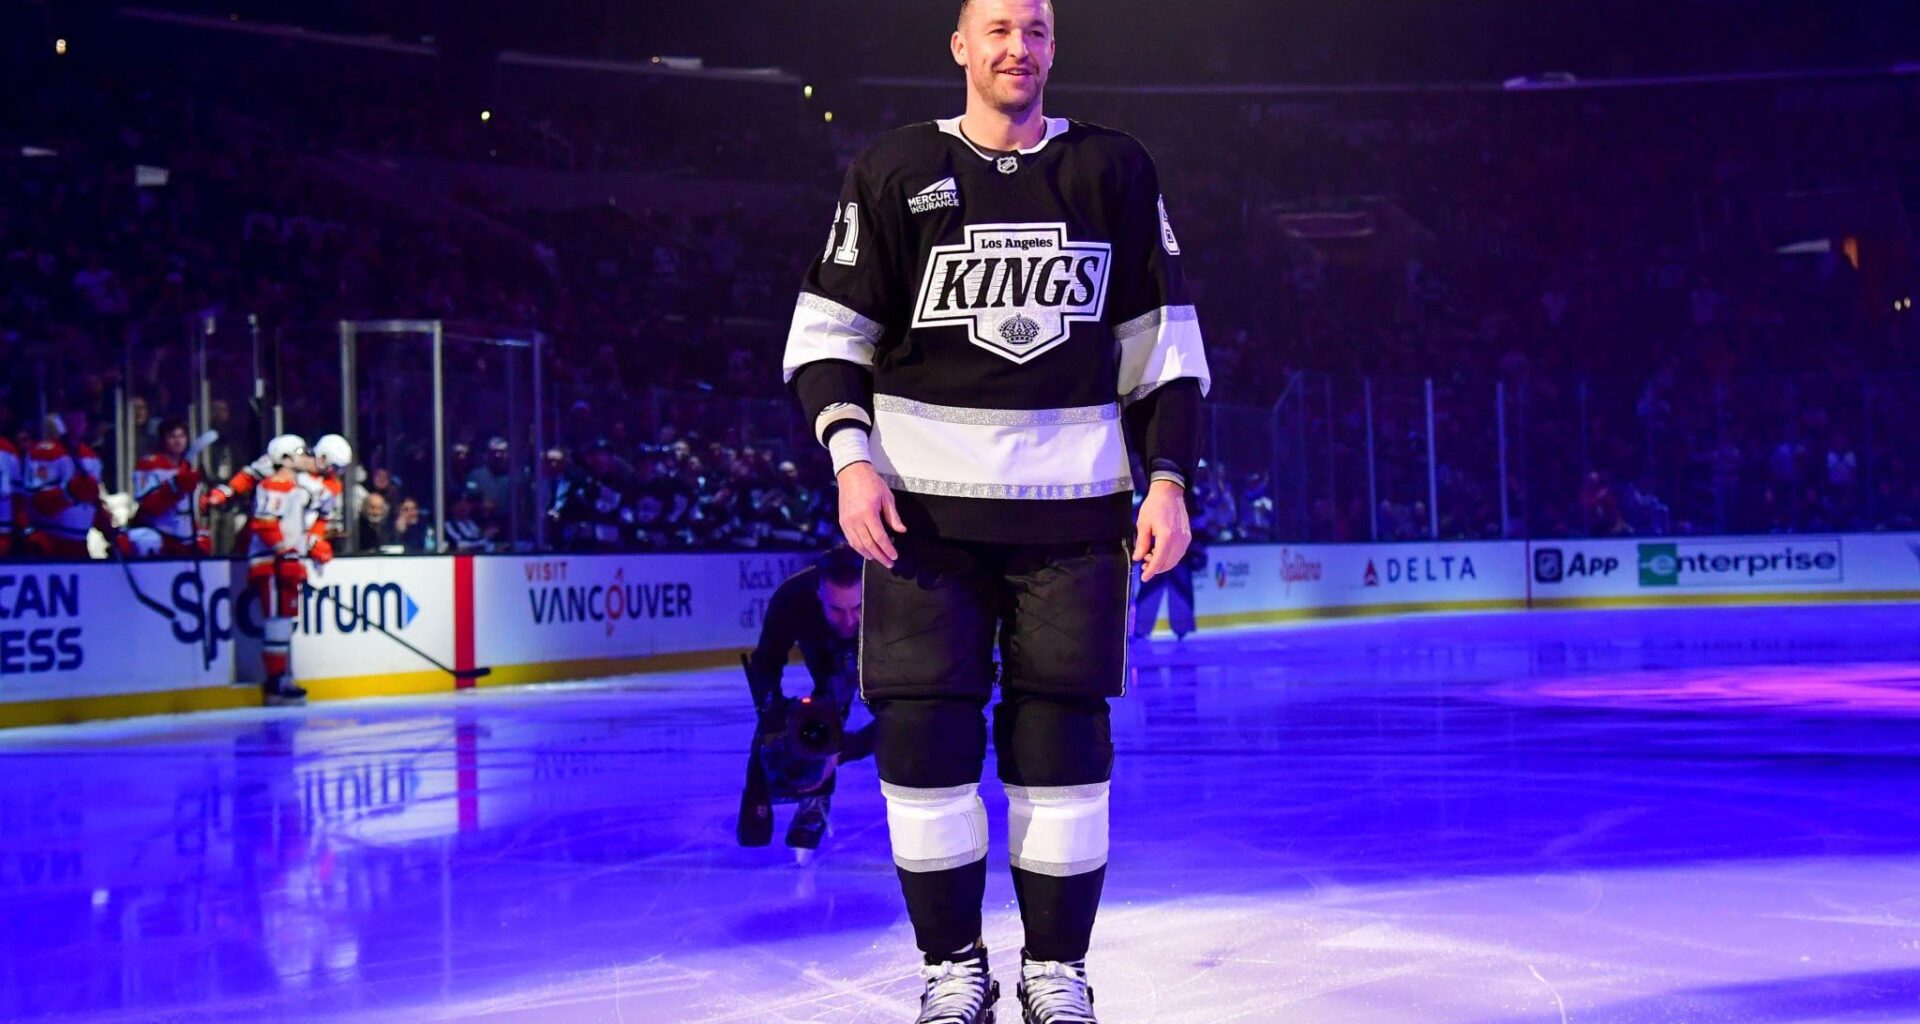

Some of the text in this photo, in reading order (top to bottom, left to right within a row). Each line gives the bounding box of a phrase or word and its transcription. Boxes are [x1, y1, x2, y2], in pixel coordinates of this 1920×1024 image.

[907, 190, 957, 207] MERCURY
[910, 198, 960, 215] INSURANCE
[981, 236, 1053, 251] Los Angeles
[933, 255, 1100, 311] KINGS
[524, 561, 567, 583] VISIT
[1385, 556, 1476, 583] DELTA
[1648, 547, 1838, 577] enterprise
[171, 571, 403, 661] Sptrum
[528, 582, 692, 625] VANCOUVER
